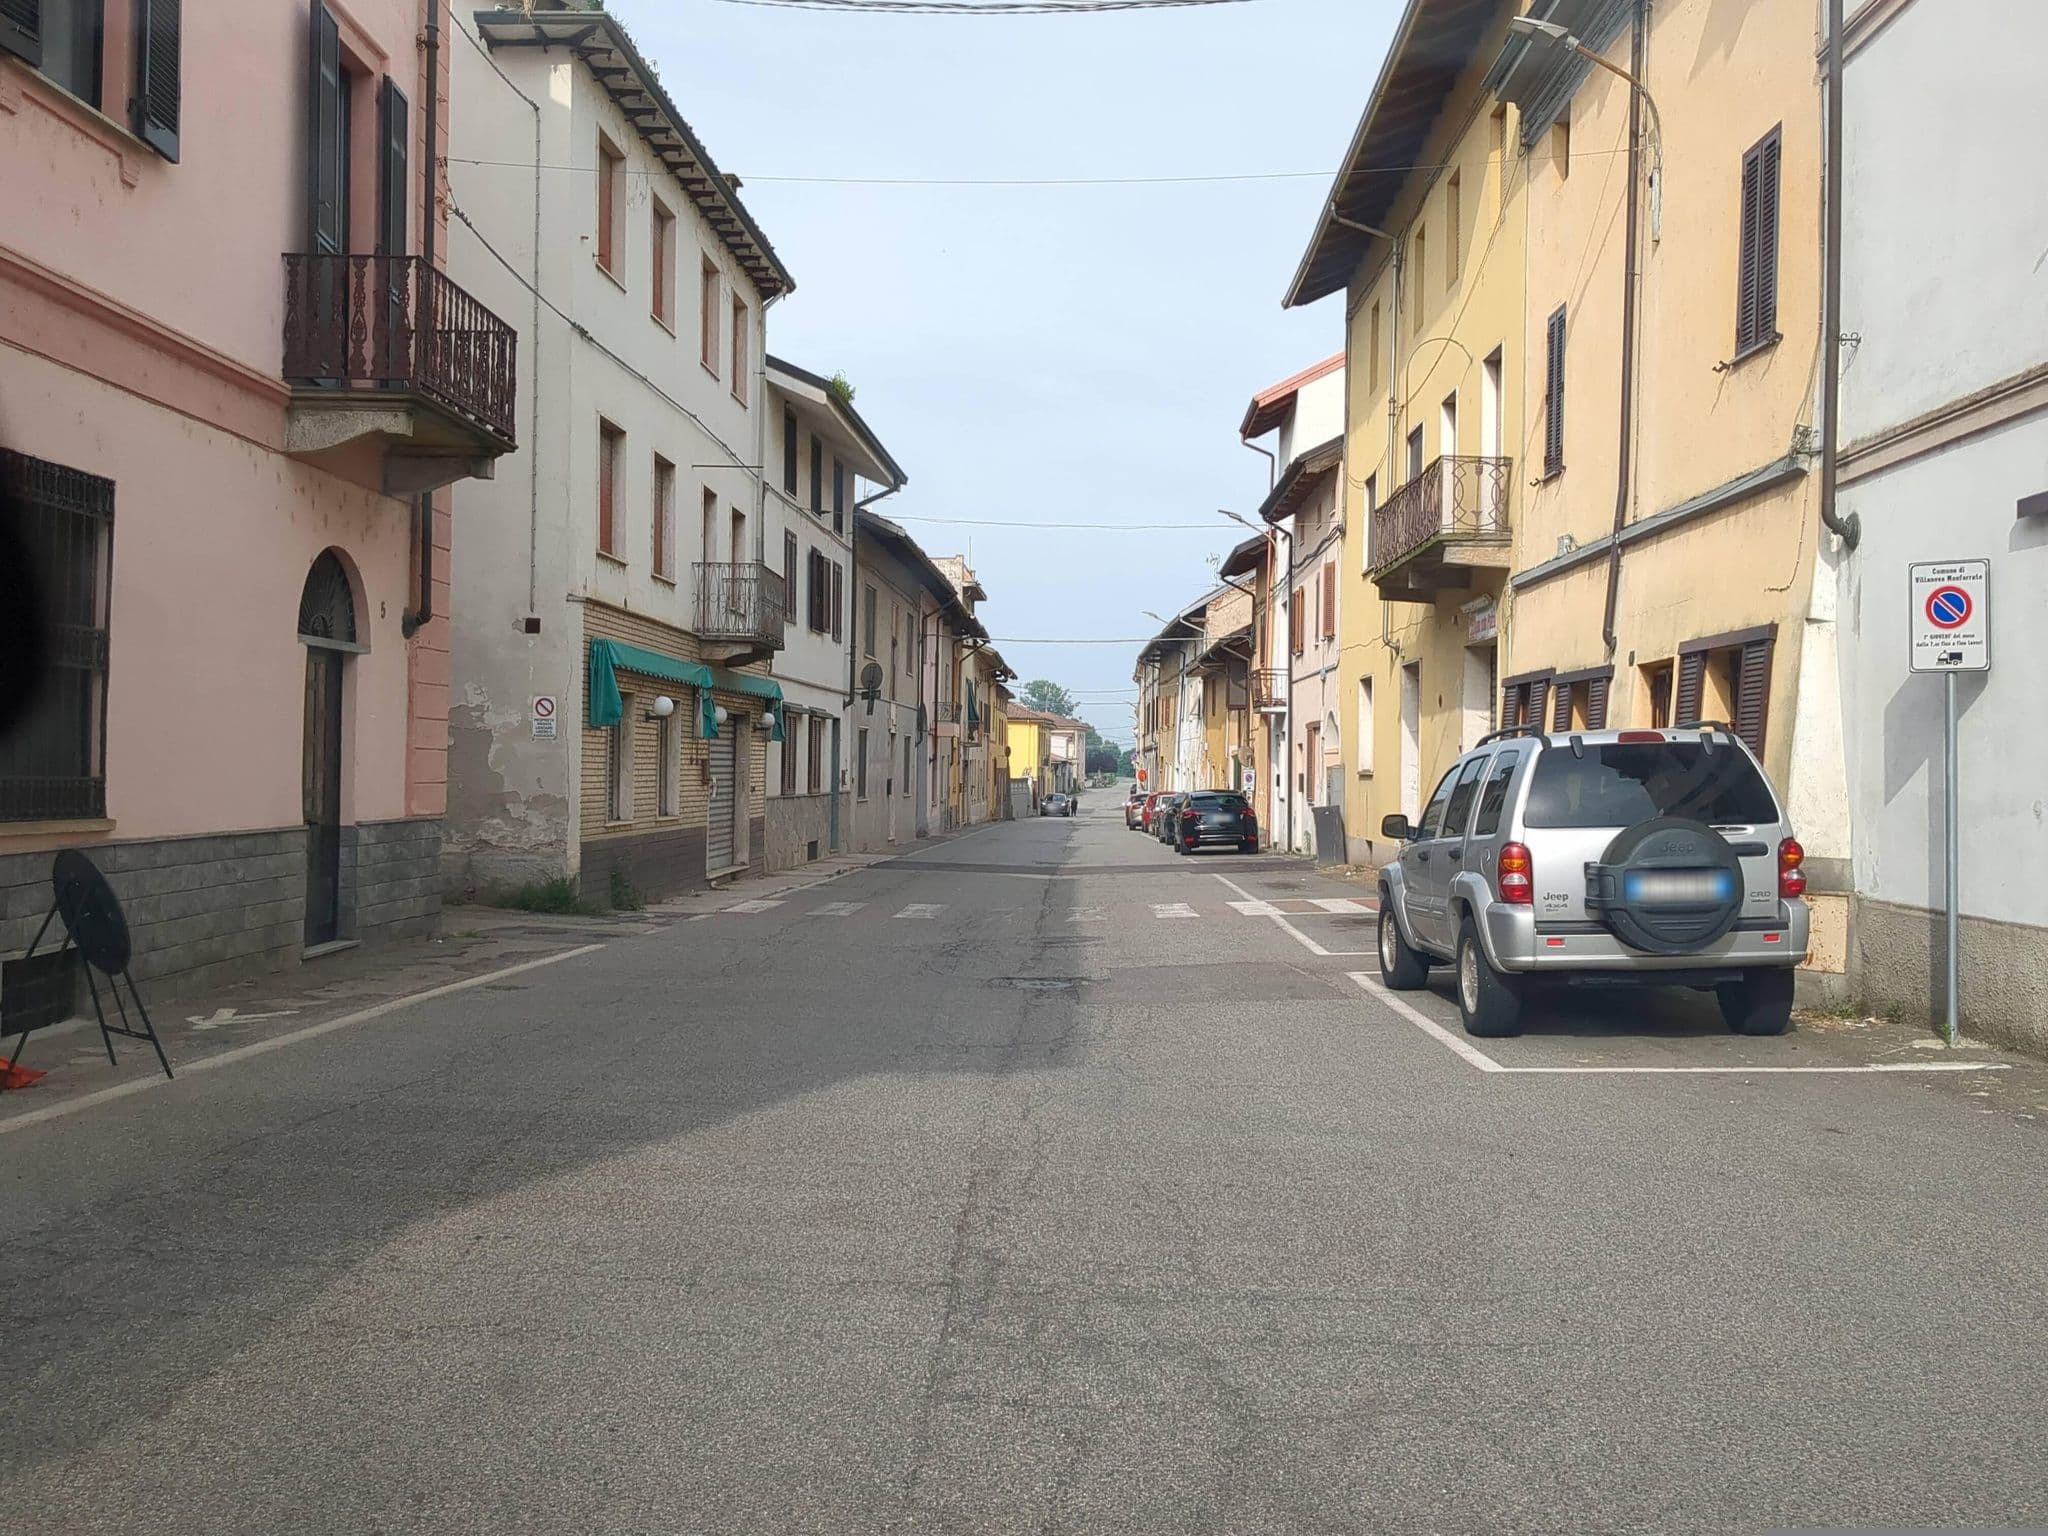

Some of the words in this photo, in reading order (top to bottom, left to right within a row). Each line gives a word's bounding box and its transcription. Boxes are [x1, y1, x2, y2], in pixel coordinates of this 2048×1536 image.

[1947, 573, 1983, 581] Monferrato
[381, 601, 386, 619] 5
[1660, 841, 1695, 855] Jeep
[1543, 892, 1569, 902] Jeep
